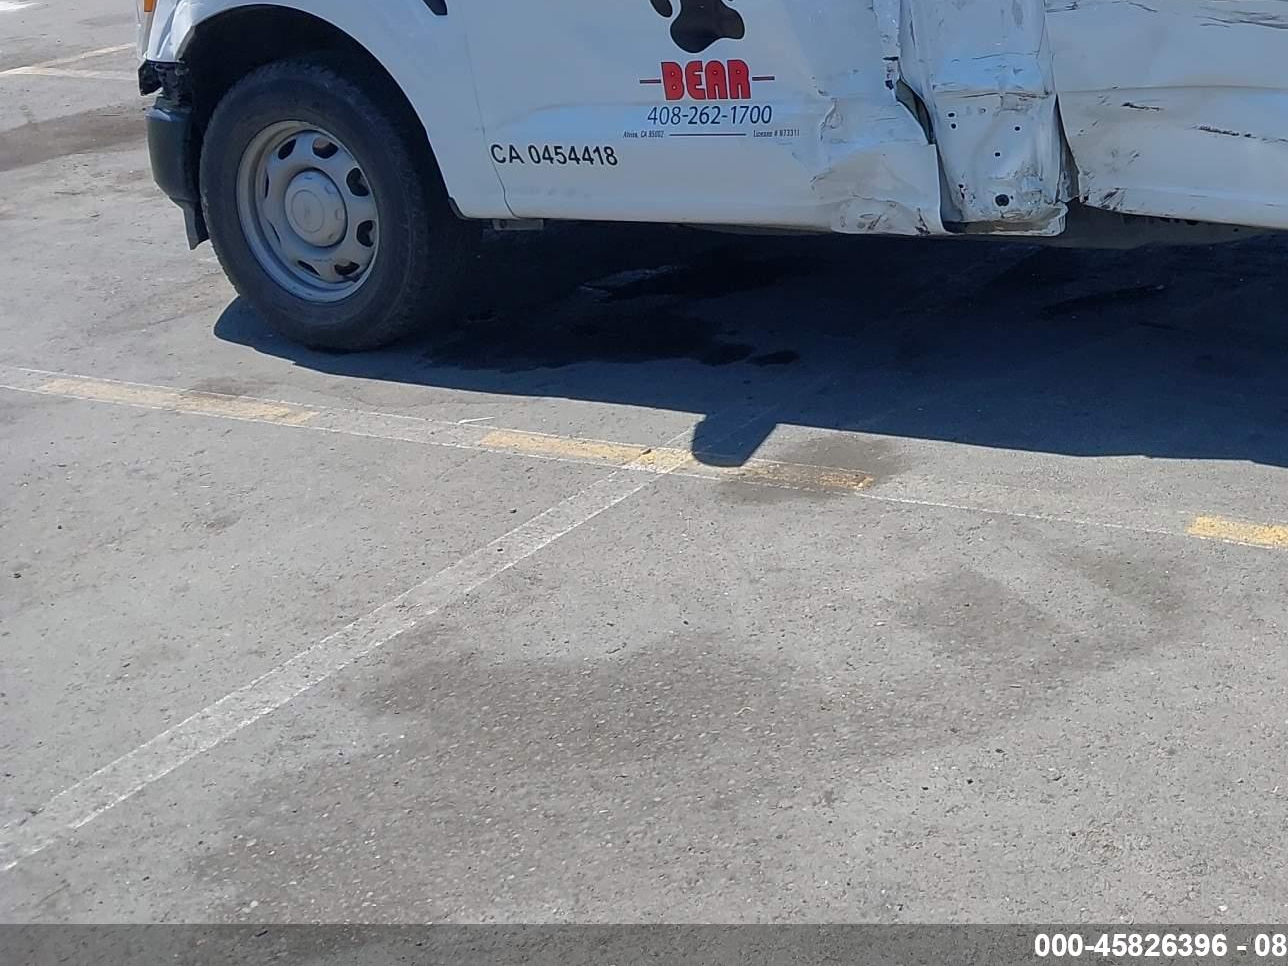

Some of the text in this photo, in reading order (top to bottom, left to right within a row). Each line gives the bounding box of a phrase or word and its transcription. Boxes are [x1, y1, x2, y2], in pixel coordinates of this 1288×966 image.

[660, 59, 752, 101] BEAR
[647, 105, 773, 126] 408-262-1700
[490, 144, 619, 166] CA 0454418
